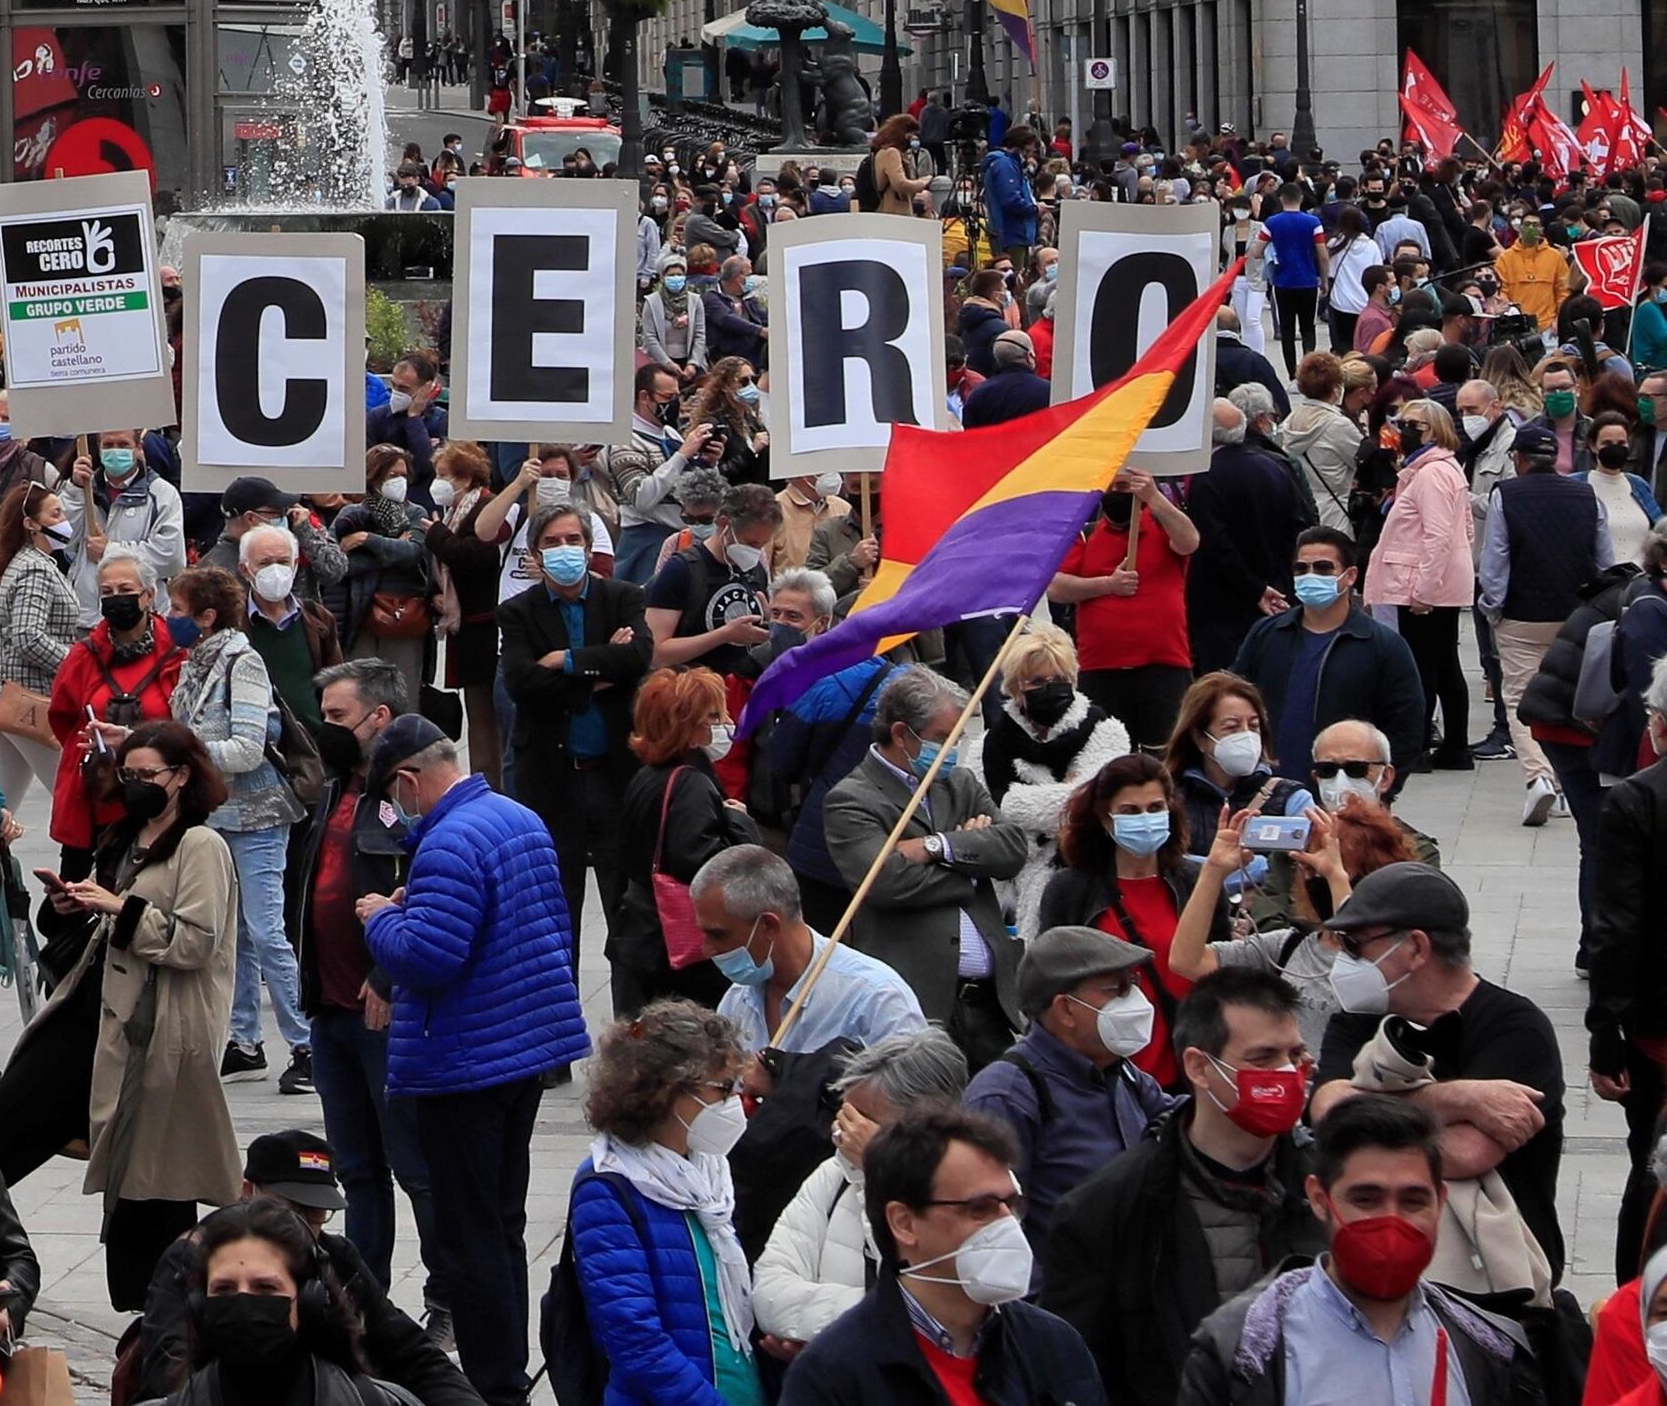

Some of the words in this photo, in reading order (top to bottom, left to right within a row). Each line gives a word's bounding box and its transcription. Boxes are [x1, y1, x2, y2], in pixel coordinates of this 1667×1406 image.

[25, 236, 84, 254] RECORTES
[39, 250, 84, 272] CERO
[15, 277, 136, 299] MUNICIPALISTAS
[26, 301, 73, 317] GRUPO
[75, 295, 127, 314] VERDE
[490, 235, 590, 403] E
[50, 342, 87, 358] partido
[798, 260, 923, 429] R
[51, 354, 103, 368] castellano
[215, 276, 329, 447] C
